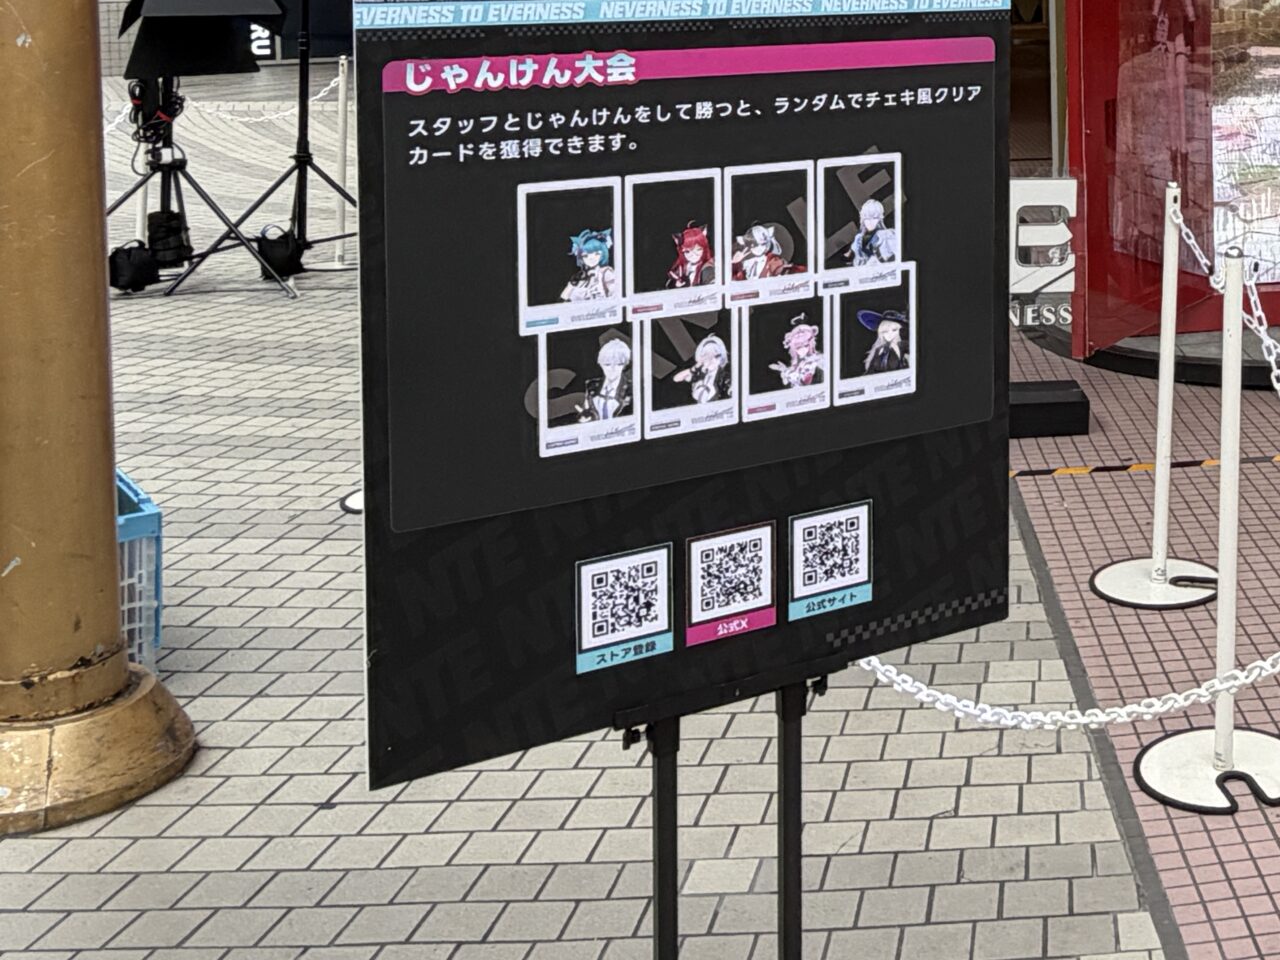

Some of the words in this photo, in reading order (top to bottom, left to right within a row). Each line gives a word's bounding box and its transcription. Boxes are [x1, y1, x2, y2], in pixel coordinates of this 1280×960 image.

[460, 4, 482, 23] TO
[487, 2, 585, 22] EVERNESS
[600, 0, 702, 18] NEVERNESS
[707, 0, 727, 16] TO
[405, 52, 636, 90] じゃんけん大会
[408, 133, 637, 165] カードを獲得できます。
[805, 591, 857, 614] 公式サイト
[716, 618, 749, 637] 公式X
[596, 641, 657, 666] ストア登録
